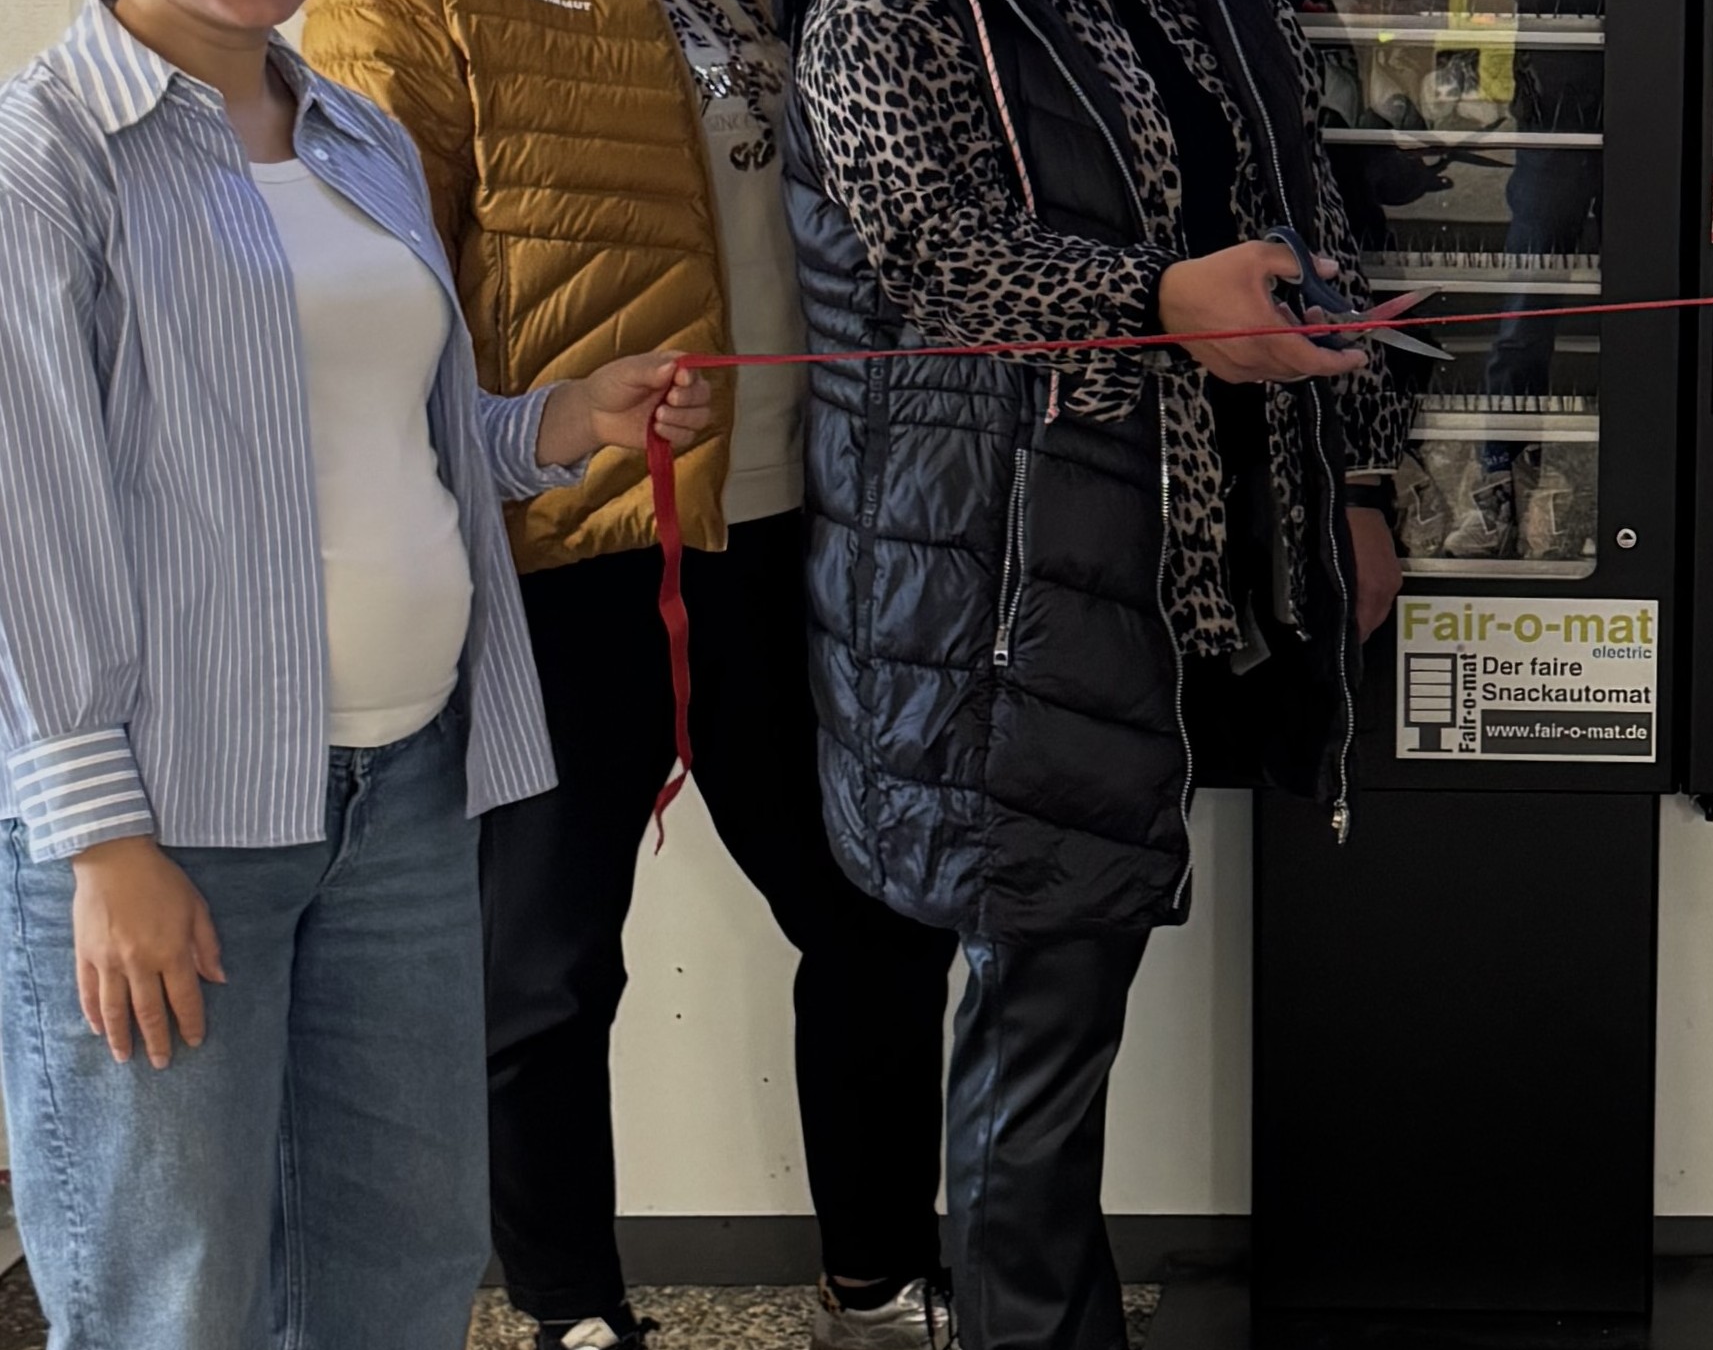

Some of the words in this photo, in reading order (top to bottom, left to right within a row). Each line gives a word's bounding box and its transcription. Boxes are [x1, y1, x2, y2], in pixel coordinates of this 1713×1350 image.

[1403, 603, 1653, 644] Fair-o-mat
[1592, 646, 1652, 659] electric
[1483, 656, 1523, 676] Der
[1530, 657, 1583, 676] faire
[1482, 683, 1652, 704] Snackautomat
[1486, 723, 1647, 740] www.fair-o-mat.de
